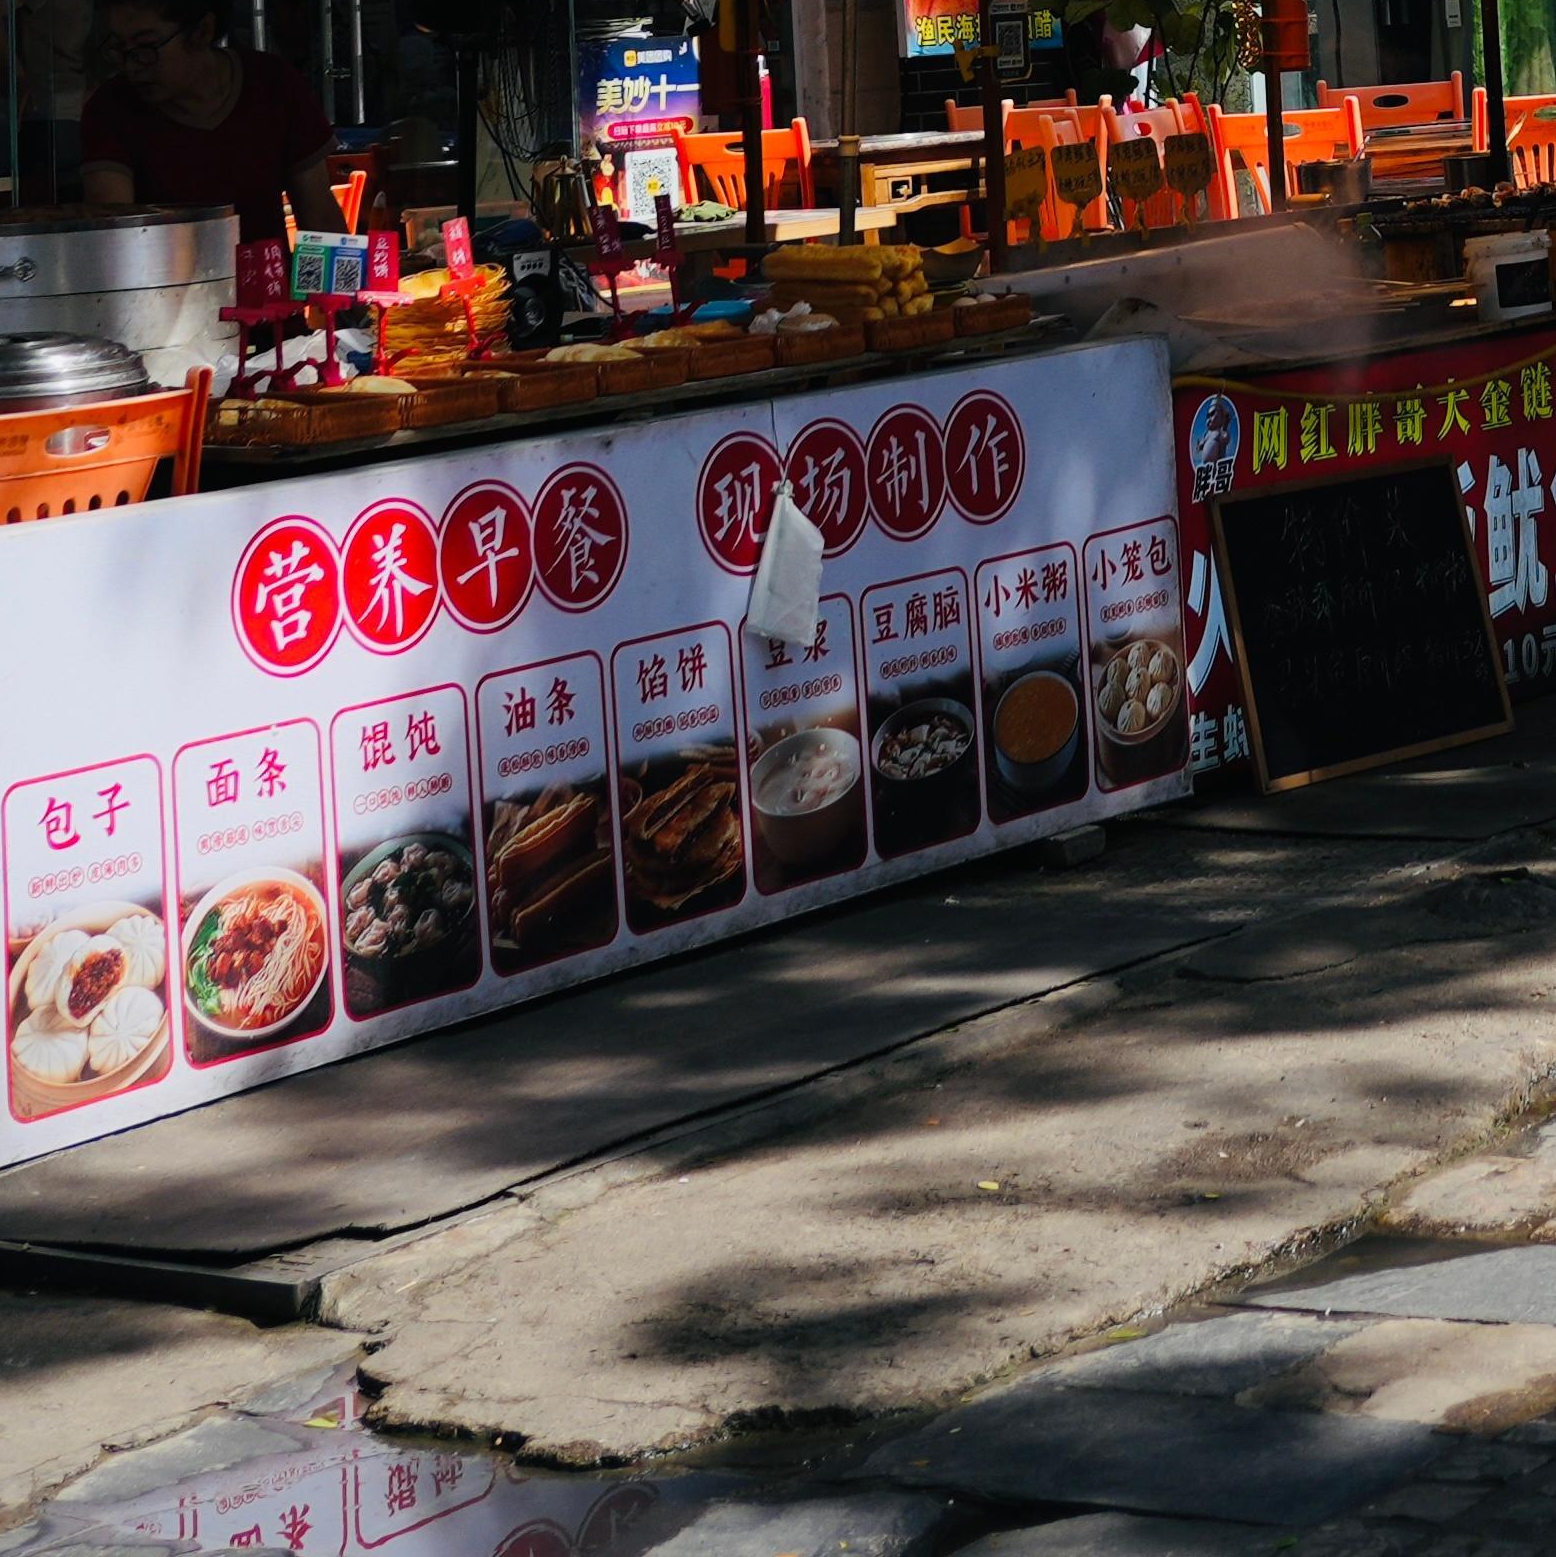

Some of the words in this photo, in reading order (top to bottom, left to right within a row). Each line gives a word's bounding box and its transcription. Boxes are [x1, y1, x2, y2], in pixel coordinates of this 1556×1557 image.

[596, 73, 701, 116] 美妙十一
[712, 408, 1013, 550] 现场制作
[1192, 457, 1236, 504] 胖哥
[251, 484, 617, 651] 营养早餐
[984, 559, 1069, 619] 小米粥
[1091, 535, 1173, 588] 小笼包
[870, 584, 962, 645] 豆腐脑
[636, 643, 708, 705] 馅饼
[502, 676, 577, 738] 油条
[205, 746, 290, 808] 面条
[358, 713, 443, 788] 馄饨
[37, 783, 132, 851] 包子
